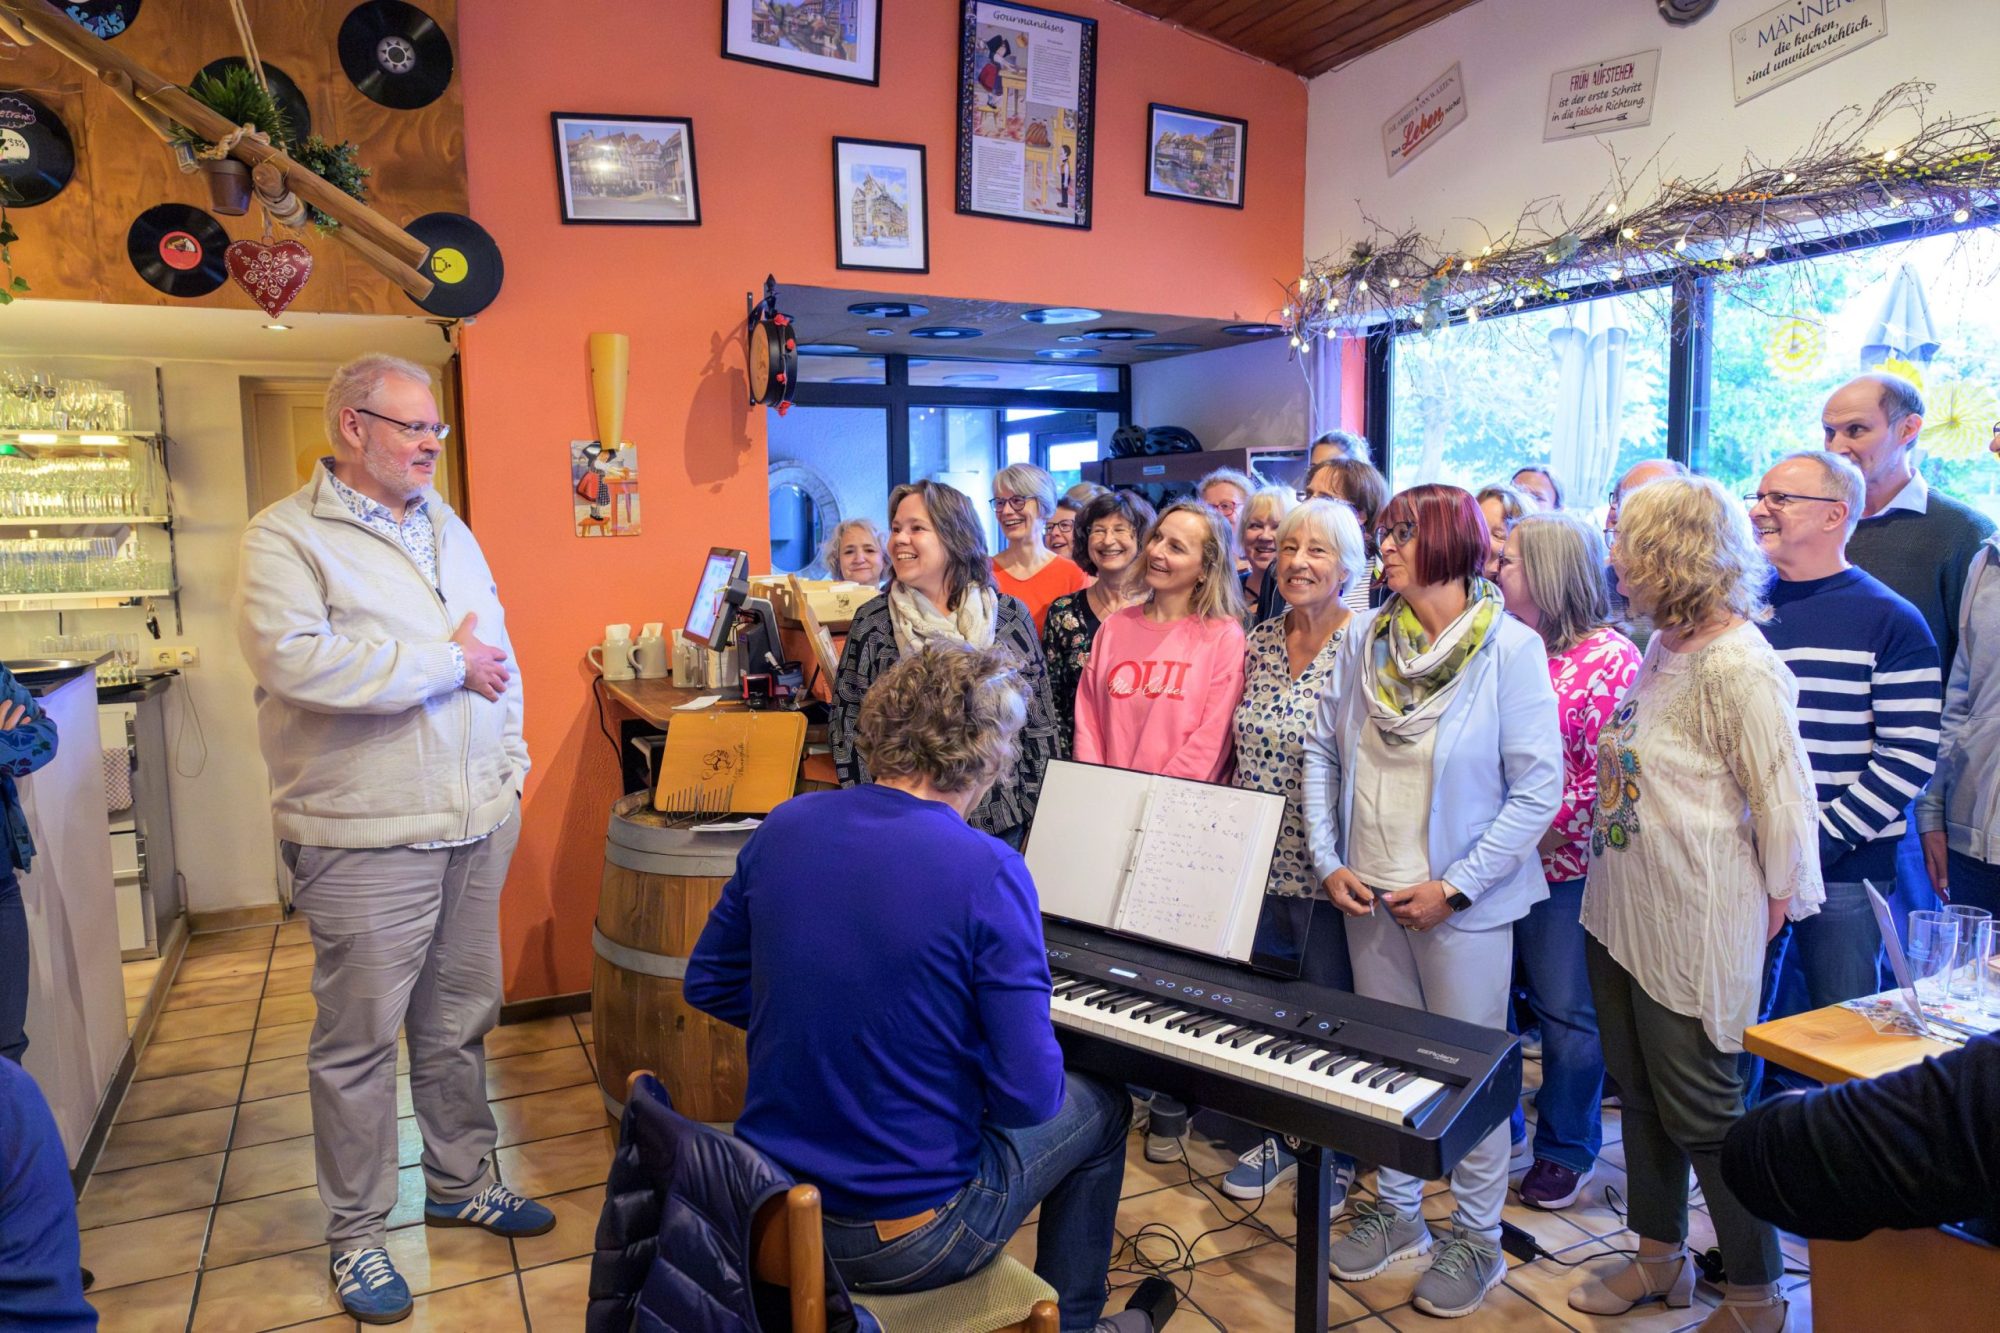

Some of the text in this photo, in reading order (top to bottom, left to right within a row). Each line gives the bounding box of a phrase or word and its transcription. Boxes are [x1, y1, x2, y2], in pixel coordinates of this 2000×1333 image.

[993, 10, 1065, 34] Gourmandises
[1746, 15, 1873, 85] sind unwiderstehlich.
[1774, 20, 1840, 57] die kochen,
[1569, 62, 1635, 92] FRÜH AUFSTEHEN
[1559, 82, 1642, 108] ist der erste Schritt
[1551, 111, 1560, 122] in
[1561, 108, 1574, 119] die
[1575, 104, 1603, 118] falsche
[1108, 660, 1193, 701] OUI
